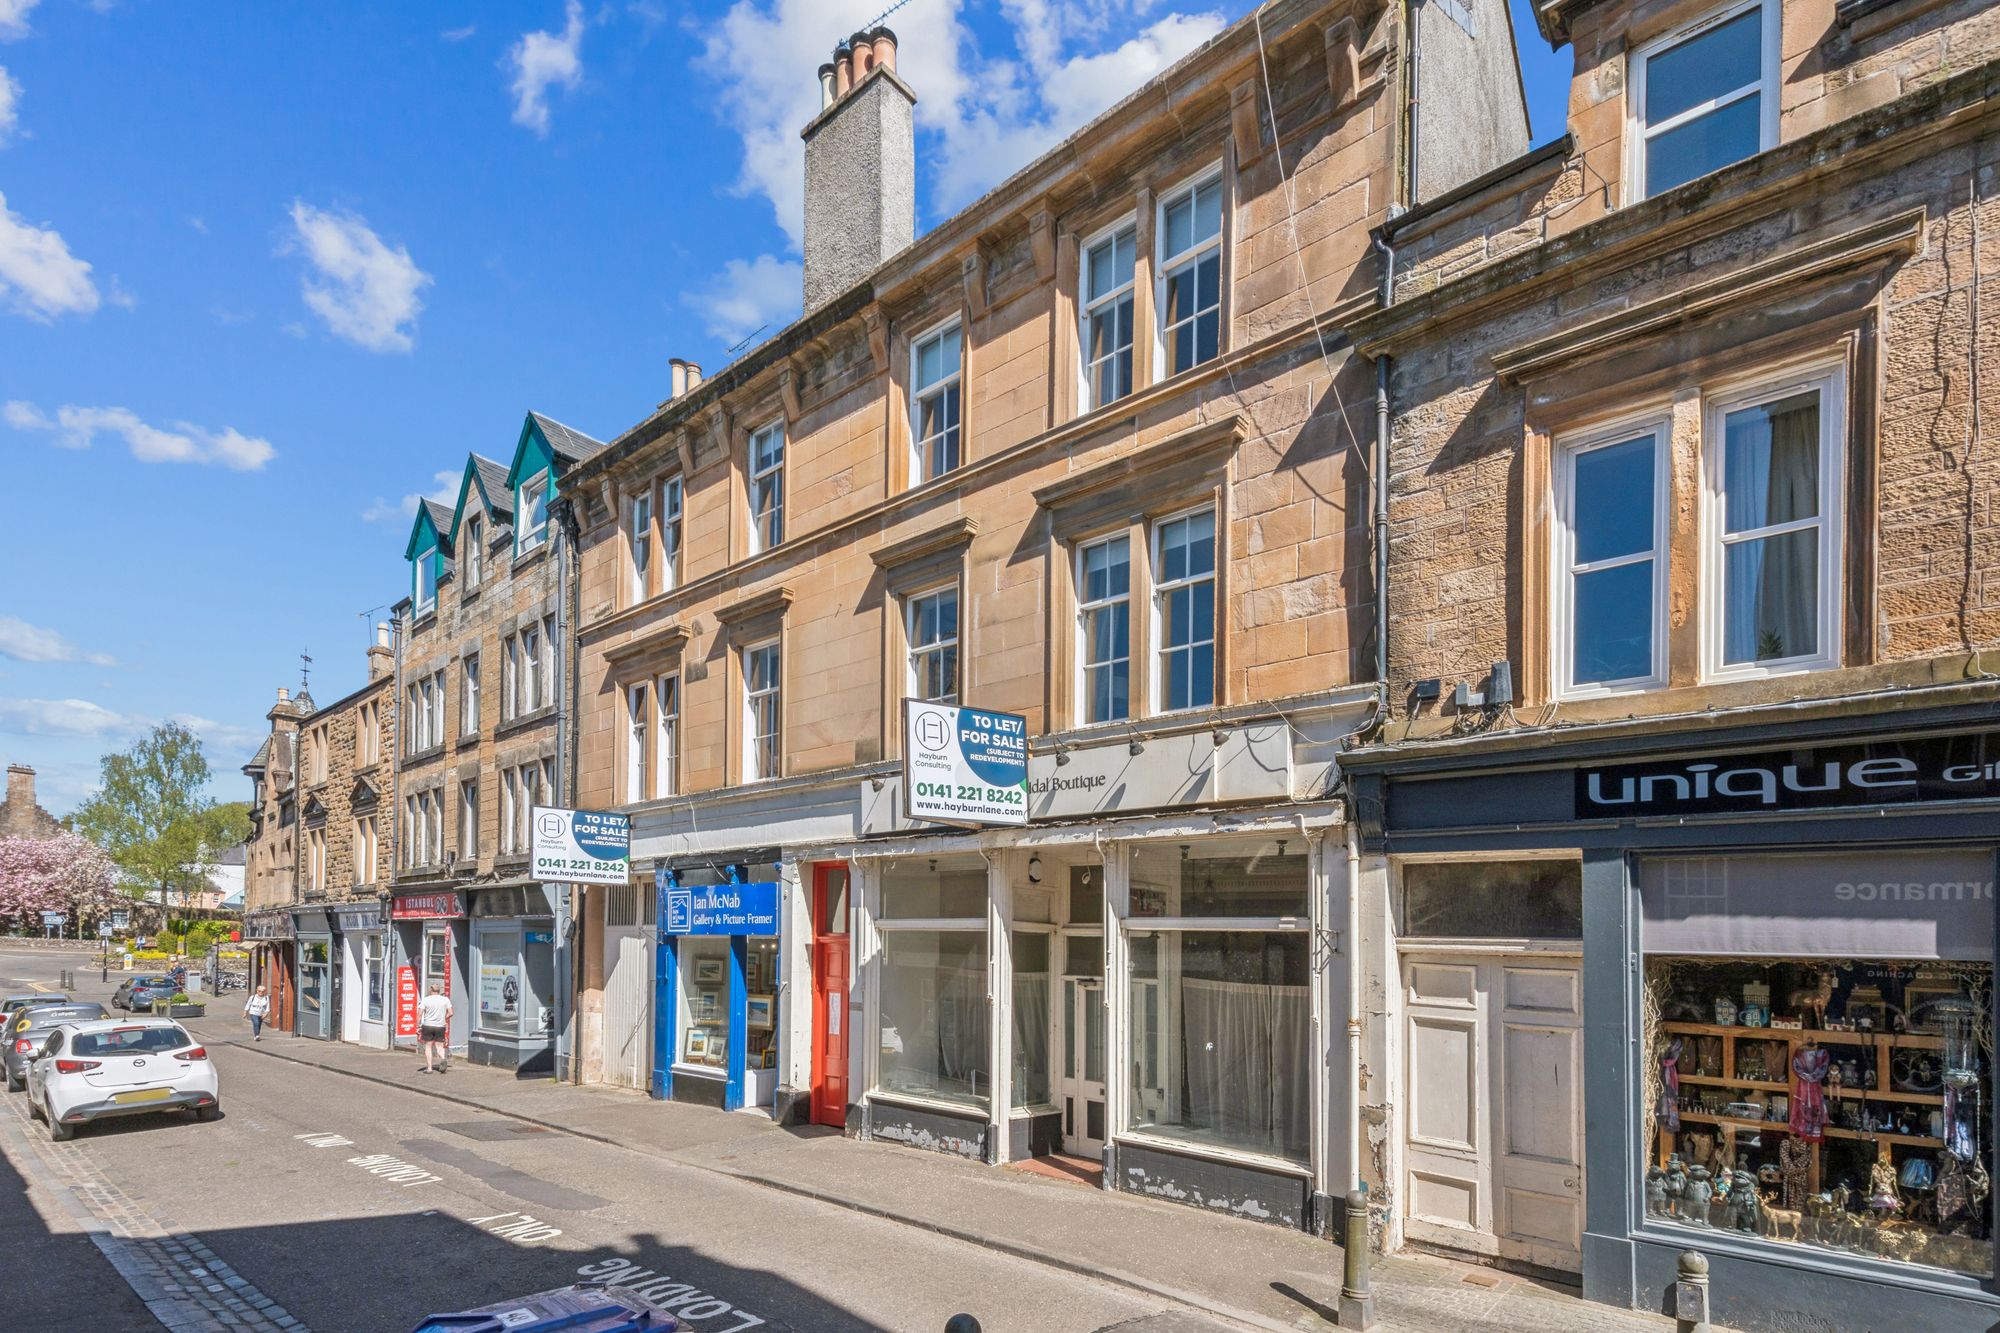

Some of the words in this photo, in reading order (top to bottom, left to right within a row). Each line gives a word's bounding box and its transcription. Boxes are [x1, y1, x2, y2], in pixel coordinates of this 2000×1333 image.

[972, 715, 991, 728] TO
[995, 719, 1022, 735] LET/
[962, 730, 989, 745] FOR
[993, 735, 1024, 749] SALE
[919, 752, 947, 762] Hayburn
[970, 753, 1024, 767] REDEVELOPMENT)
[987, 748, 1015, 758] (SUBJECT
[915, 760, 951, 771] Consulting
[1052, 775, 1106, 792] Boutique
[1588, 757, 1918, 804] unique
[917, 782, 952, 799] 0141
[957, 786, 982, 801] 221
[987, 789, 1022, 805] 8242
[917, 801, 1023, 817] www.hayburnlane.com
[585, 815, 600, 824] TO
[603, 817, 627, 827] LET/
[575, 824, 598, 834] FOR
[600, 828, 628, 836] SALE
[538, 858, 566, 868] 0141
[570, 860, 590, 870] 221
[594, 862, 624, 872] 8242
[537, 870, 625, 880] www.hayburnlane.com
[694, 896, 706, 910] Ian
[709, 893, 740, 909] McNab
[693, 914, 714, 927] Gallery
[716, 914, 721, 925] &
[723, 913, 745, 925] Picture
[747, 913, 773, 924] Framer
[347, 1154, 443, 1188] LOADING
[466, 1212, 563, 1243] ONLY
